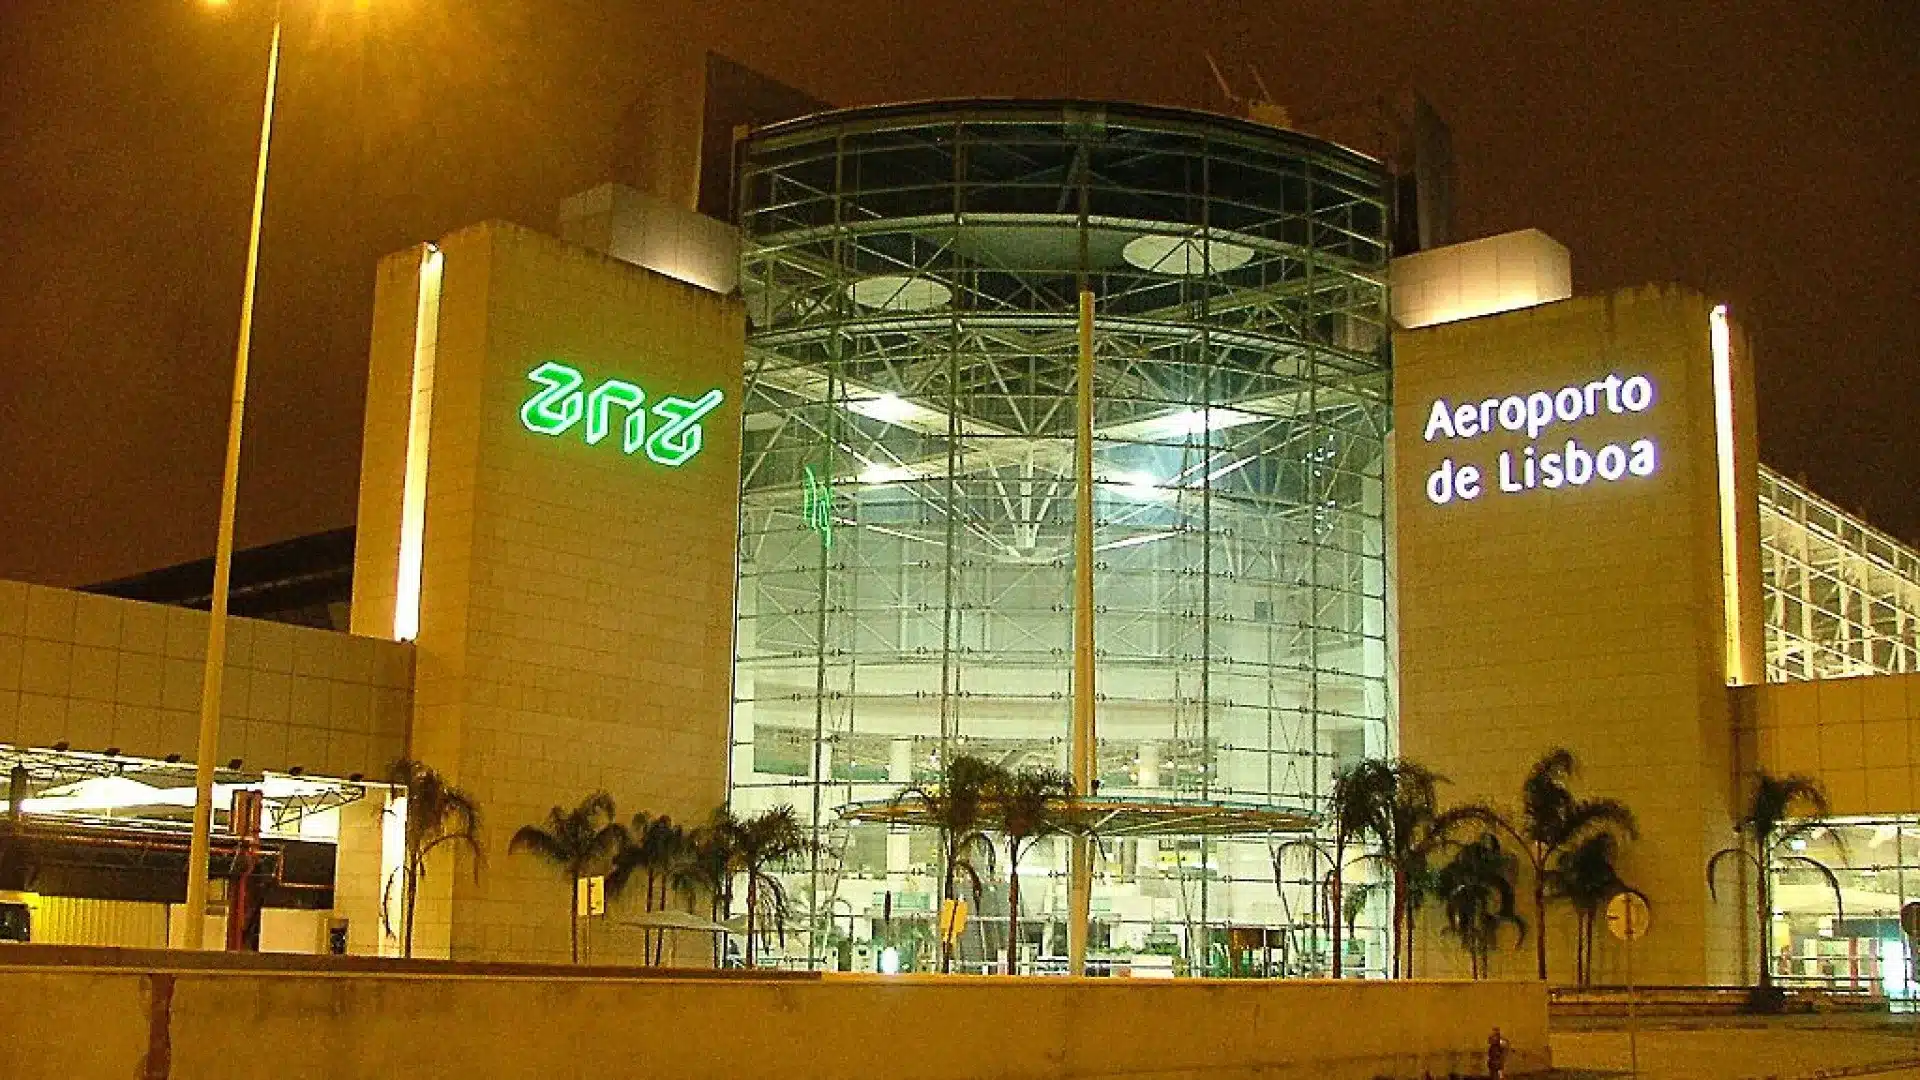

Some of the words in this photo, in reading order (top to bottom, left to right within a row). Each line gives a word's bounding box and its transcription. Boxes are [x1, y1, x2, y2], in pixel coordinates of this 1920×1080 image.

[1424, 374, 1653, 441] Aeroporto
[1426, 458, 1481, 504] de
[1499, 439, 1656, 492] Lisboa
